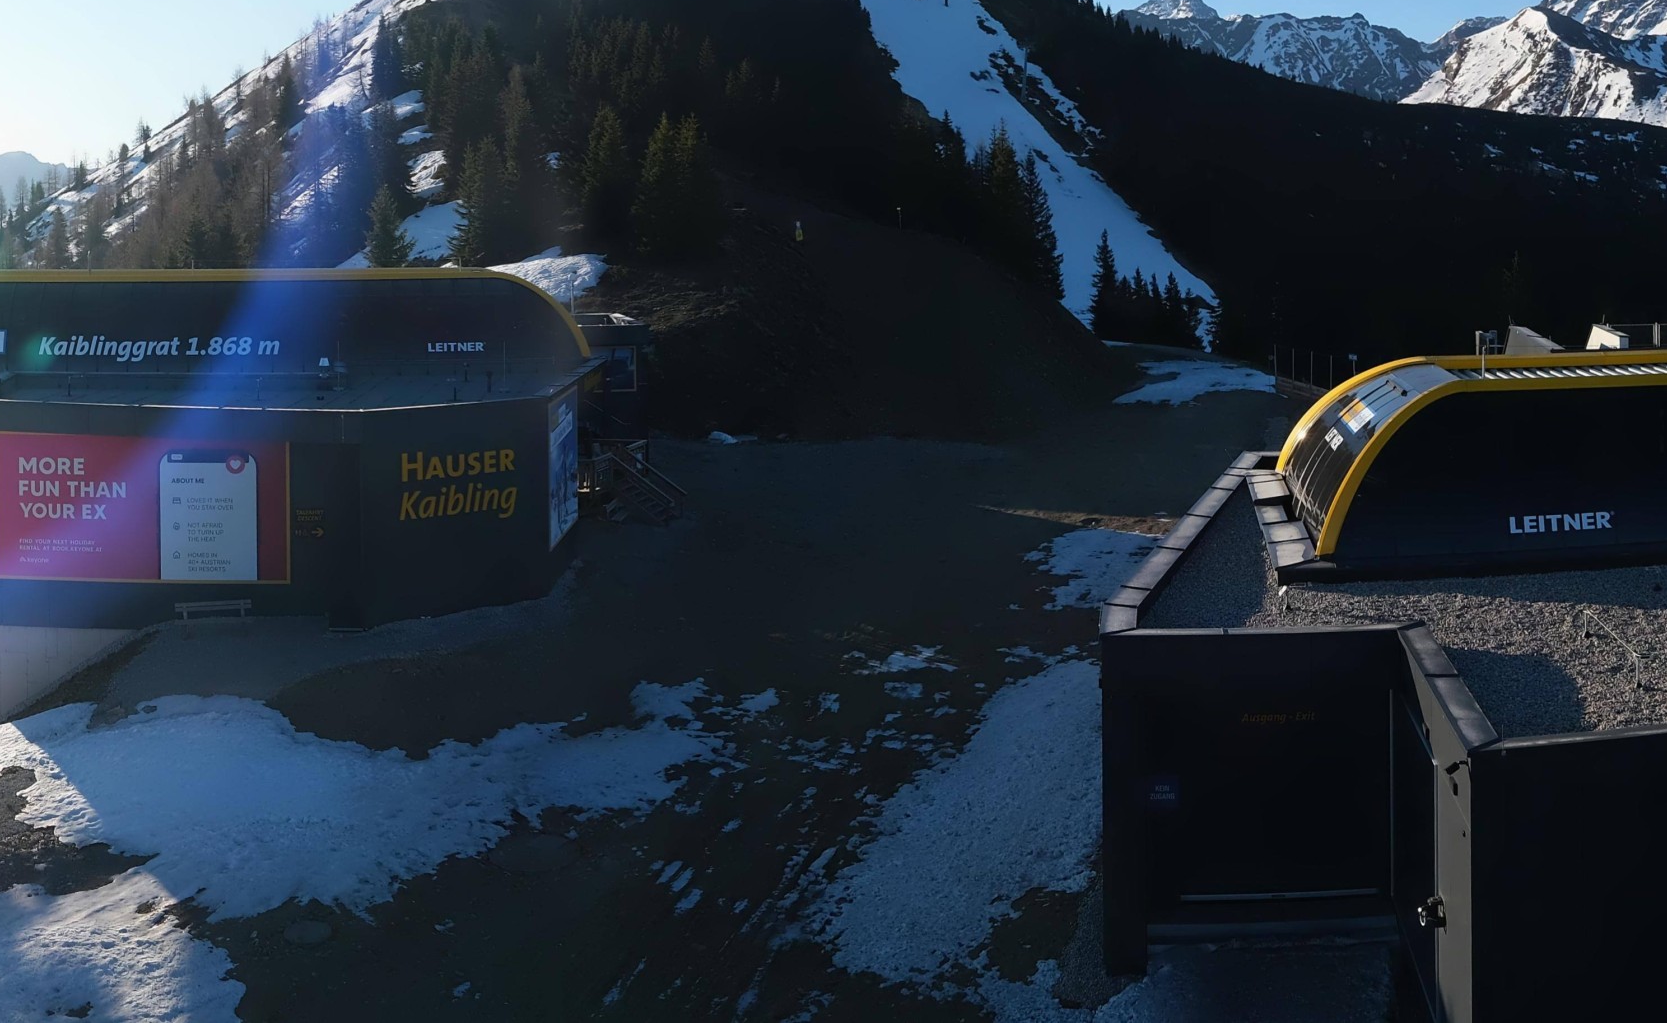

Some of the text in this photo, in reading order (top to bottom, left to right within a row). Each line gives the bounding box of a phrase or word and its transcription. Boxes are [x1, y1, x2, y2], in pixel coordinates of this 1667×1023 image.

[39, 336, 280, 361] Kaiblinggrat 1.868 m
[428, 342, 484, 352] LEITNER
[18, 457, 85, 475] MORE
[401, 449, 515, 482] HAUSER
[18, 480, 127, 498] FUN THAN
[400, 483, 517, 521] Kaibling
[20, 503, 107, 520] YOUR EX
[1509, 512, 1613, 534] LEITNER
[1241, 713, 1287, 725] Ausgang
[1296, 711, 1315, 721] Exit
